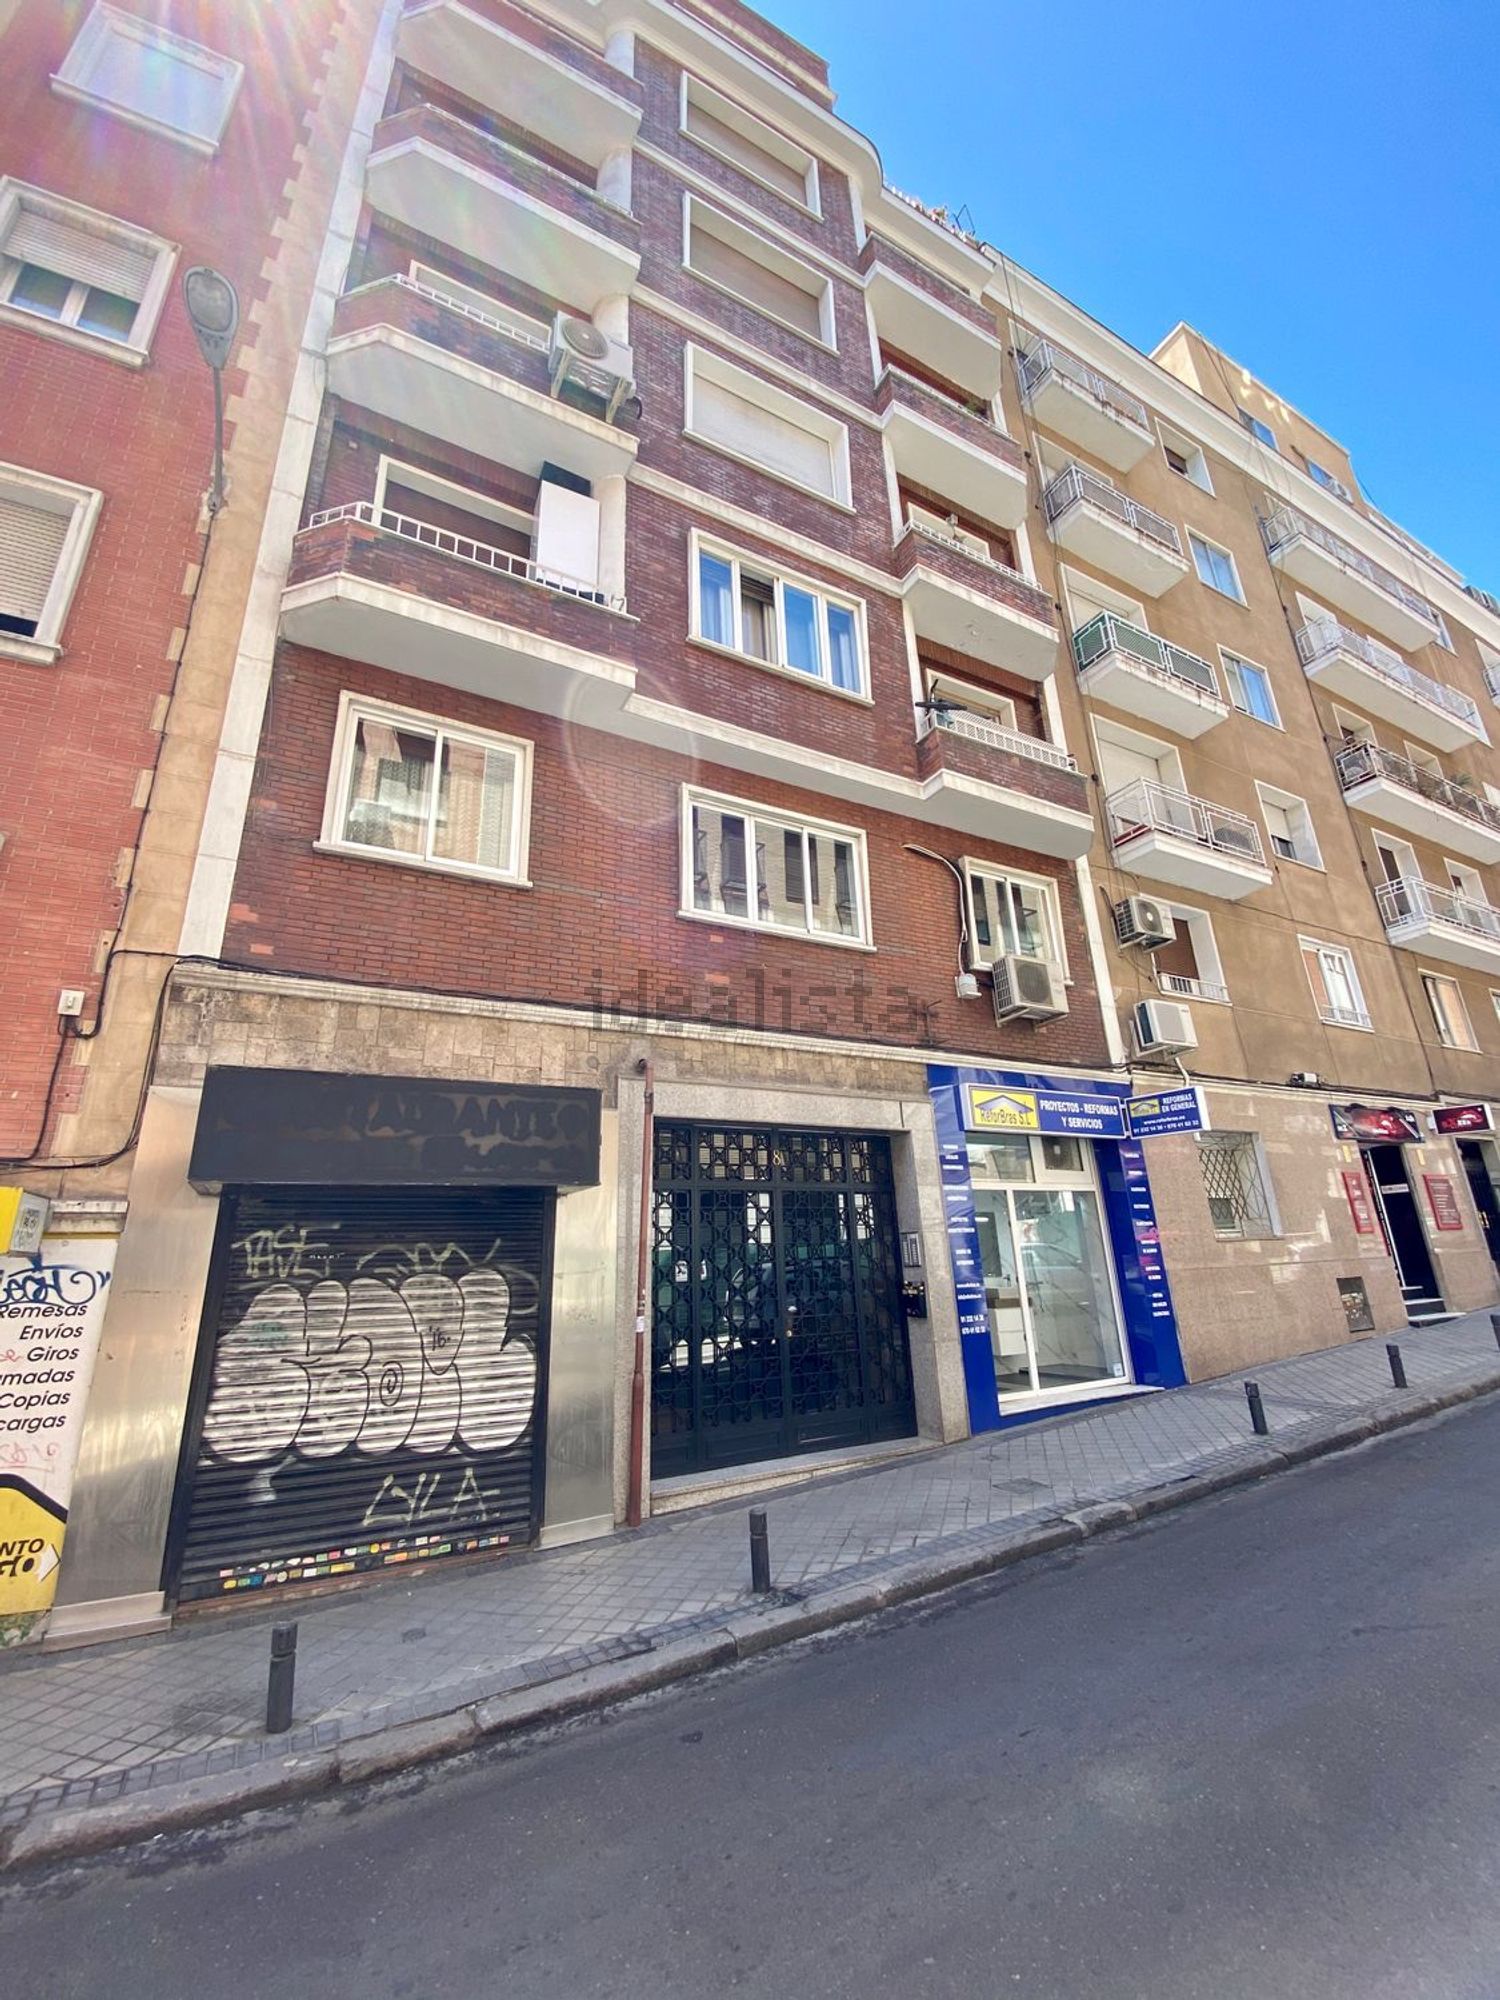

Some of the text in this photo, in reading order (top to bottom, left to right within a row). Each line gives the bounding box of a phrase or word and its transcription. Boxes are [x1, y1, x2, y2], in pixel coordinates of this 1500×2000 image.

[1040, 1100, 1080, 1114] PROYECTOS
[1084, 1103, 1119, 1116] REFORMAS
[1061, 1117, 1103, 1130] Y SERVICIOS
[0, 1304, 87, 1319] Remesas
[19, 1323, 84, 1340] Envíos
[27, 1346, 79, 1362] Giros
[0, 1390, 71, 1410] Copias
